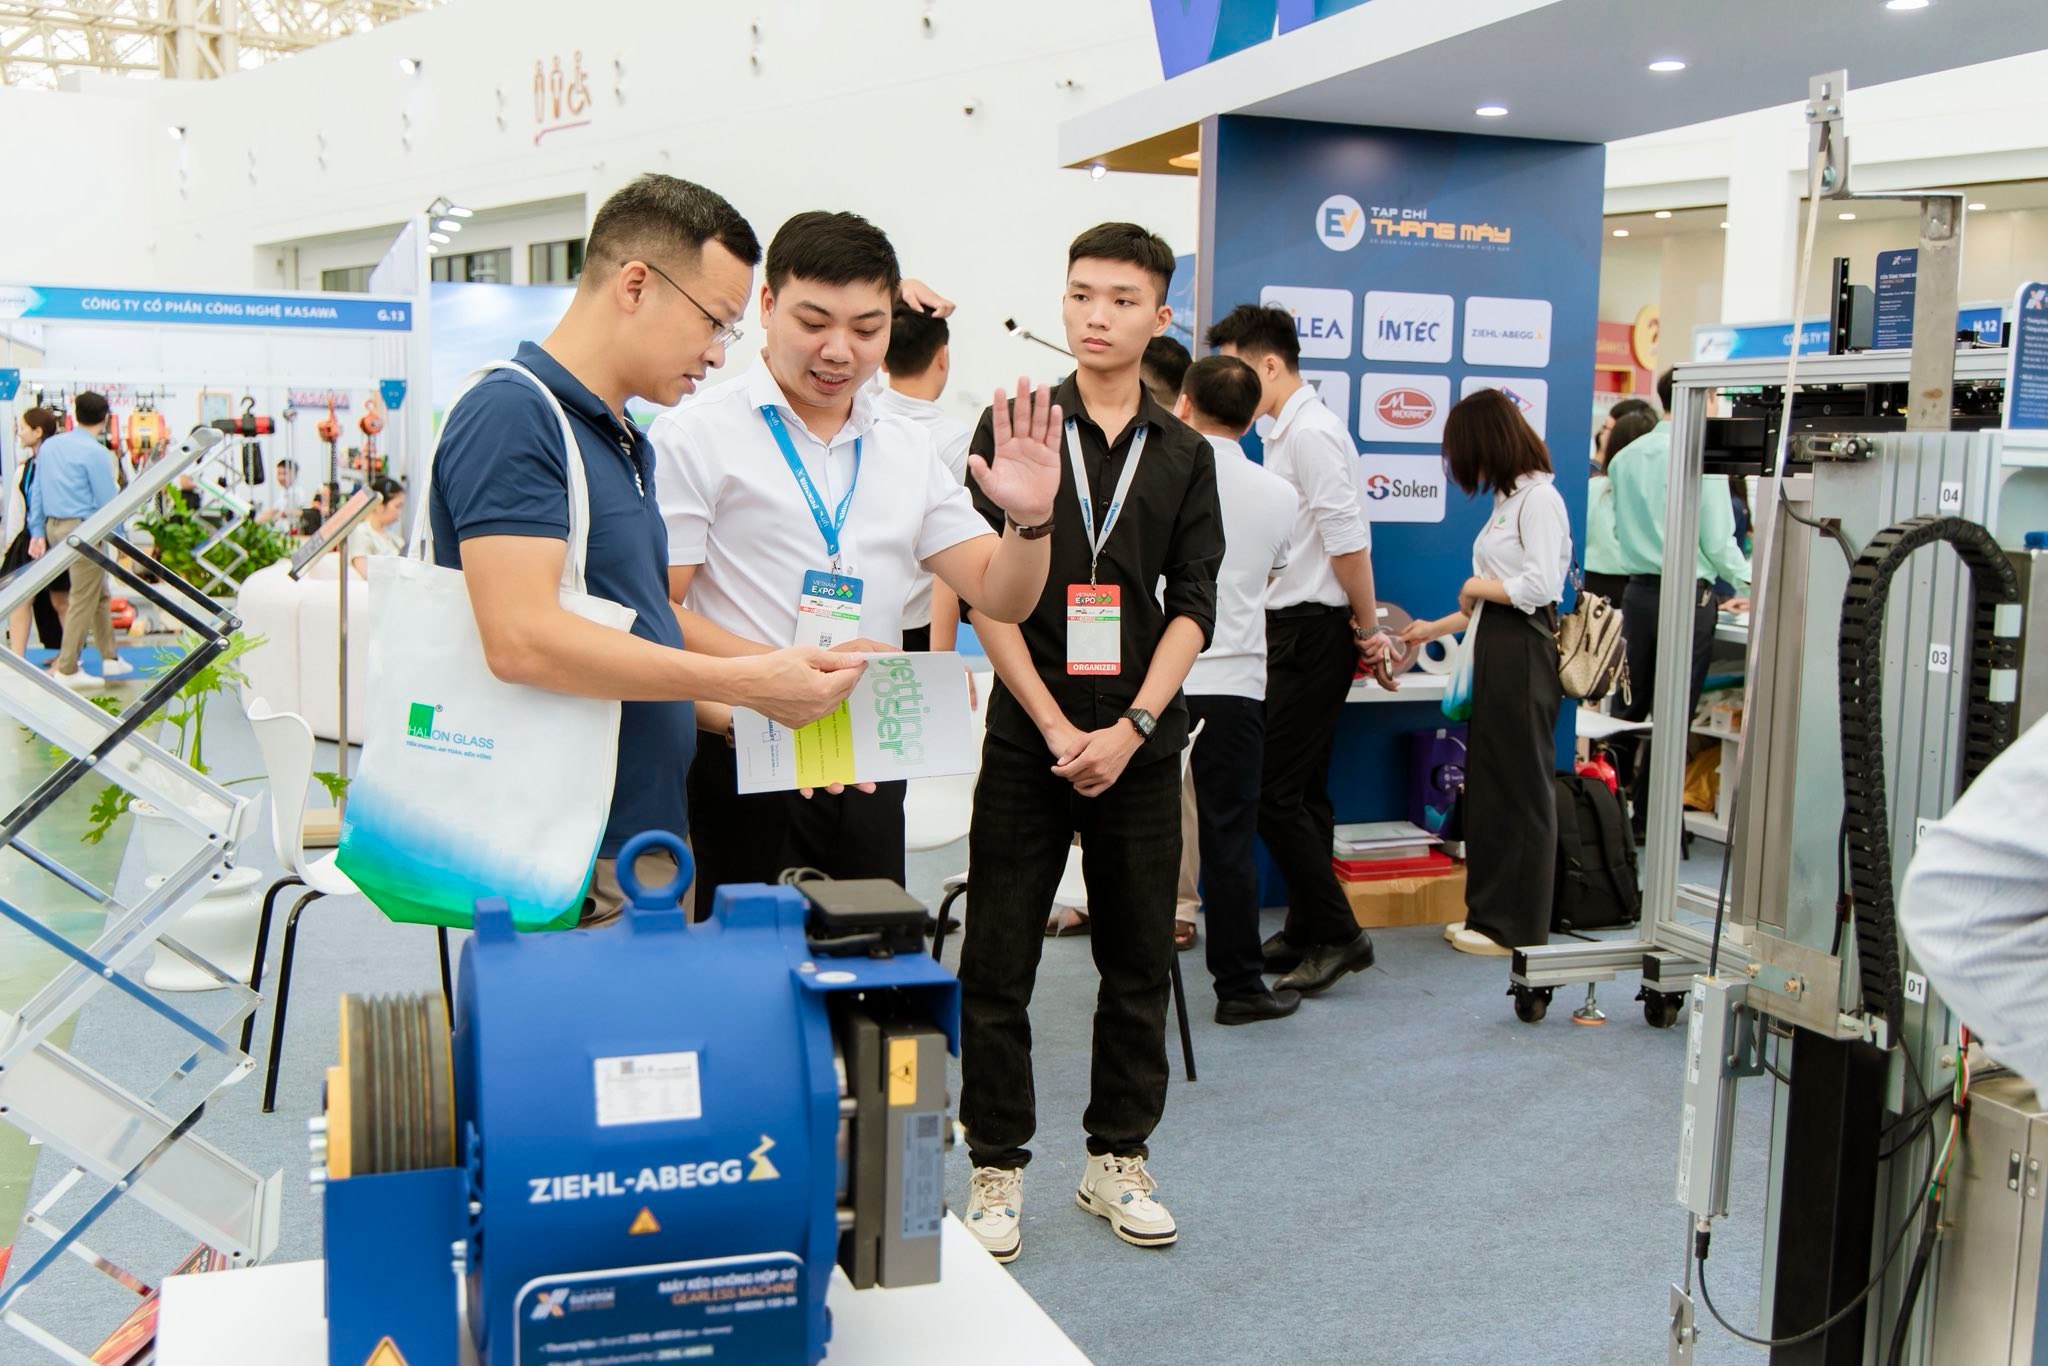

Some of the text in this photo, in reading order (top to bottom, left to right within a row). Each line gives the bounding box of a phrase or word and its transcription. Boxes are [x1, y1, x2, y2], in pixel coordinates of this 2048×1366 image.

[1370, 218, 1511, 243] THANG MÁY
[81, 296, 121, 311] CÔNG
[124, 299, 141, 312] TY
[205, 301, 244, 316] CÔNG
[284, 306, 338, 320] KASAWA
[376, 309, 406, 322] G.13
[1392, 479, 1438, 498] Soken
[1943, 488, 1959, 503] 04
[1932, 650, 1948, 665] 03
[1072, 663, 1117, 672] ORGANIZER
[453, 733, 495, 750] GLASS
[1908, 979, 1923, 996] 01
[527, 1158, 743, 1204] ZIEHL-ABEGG
